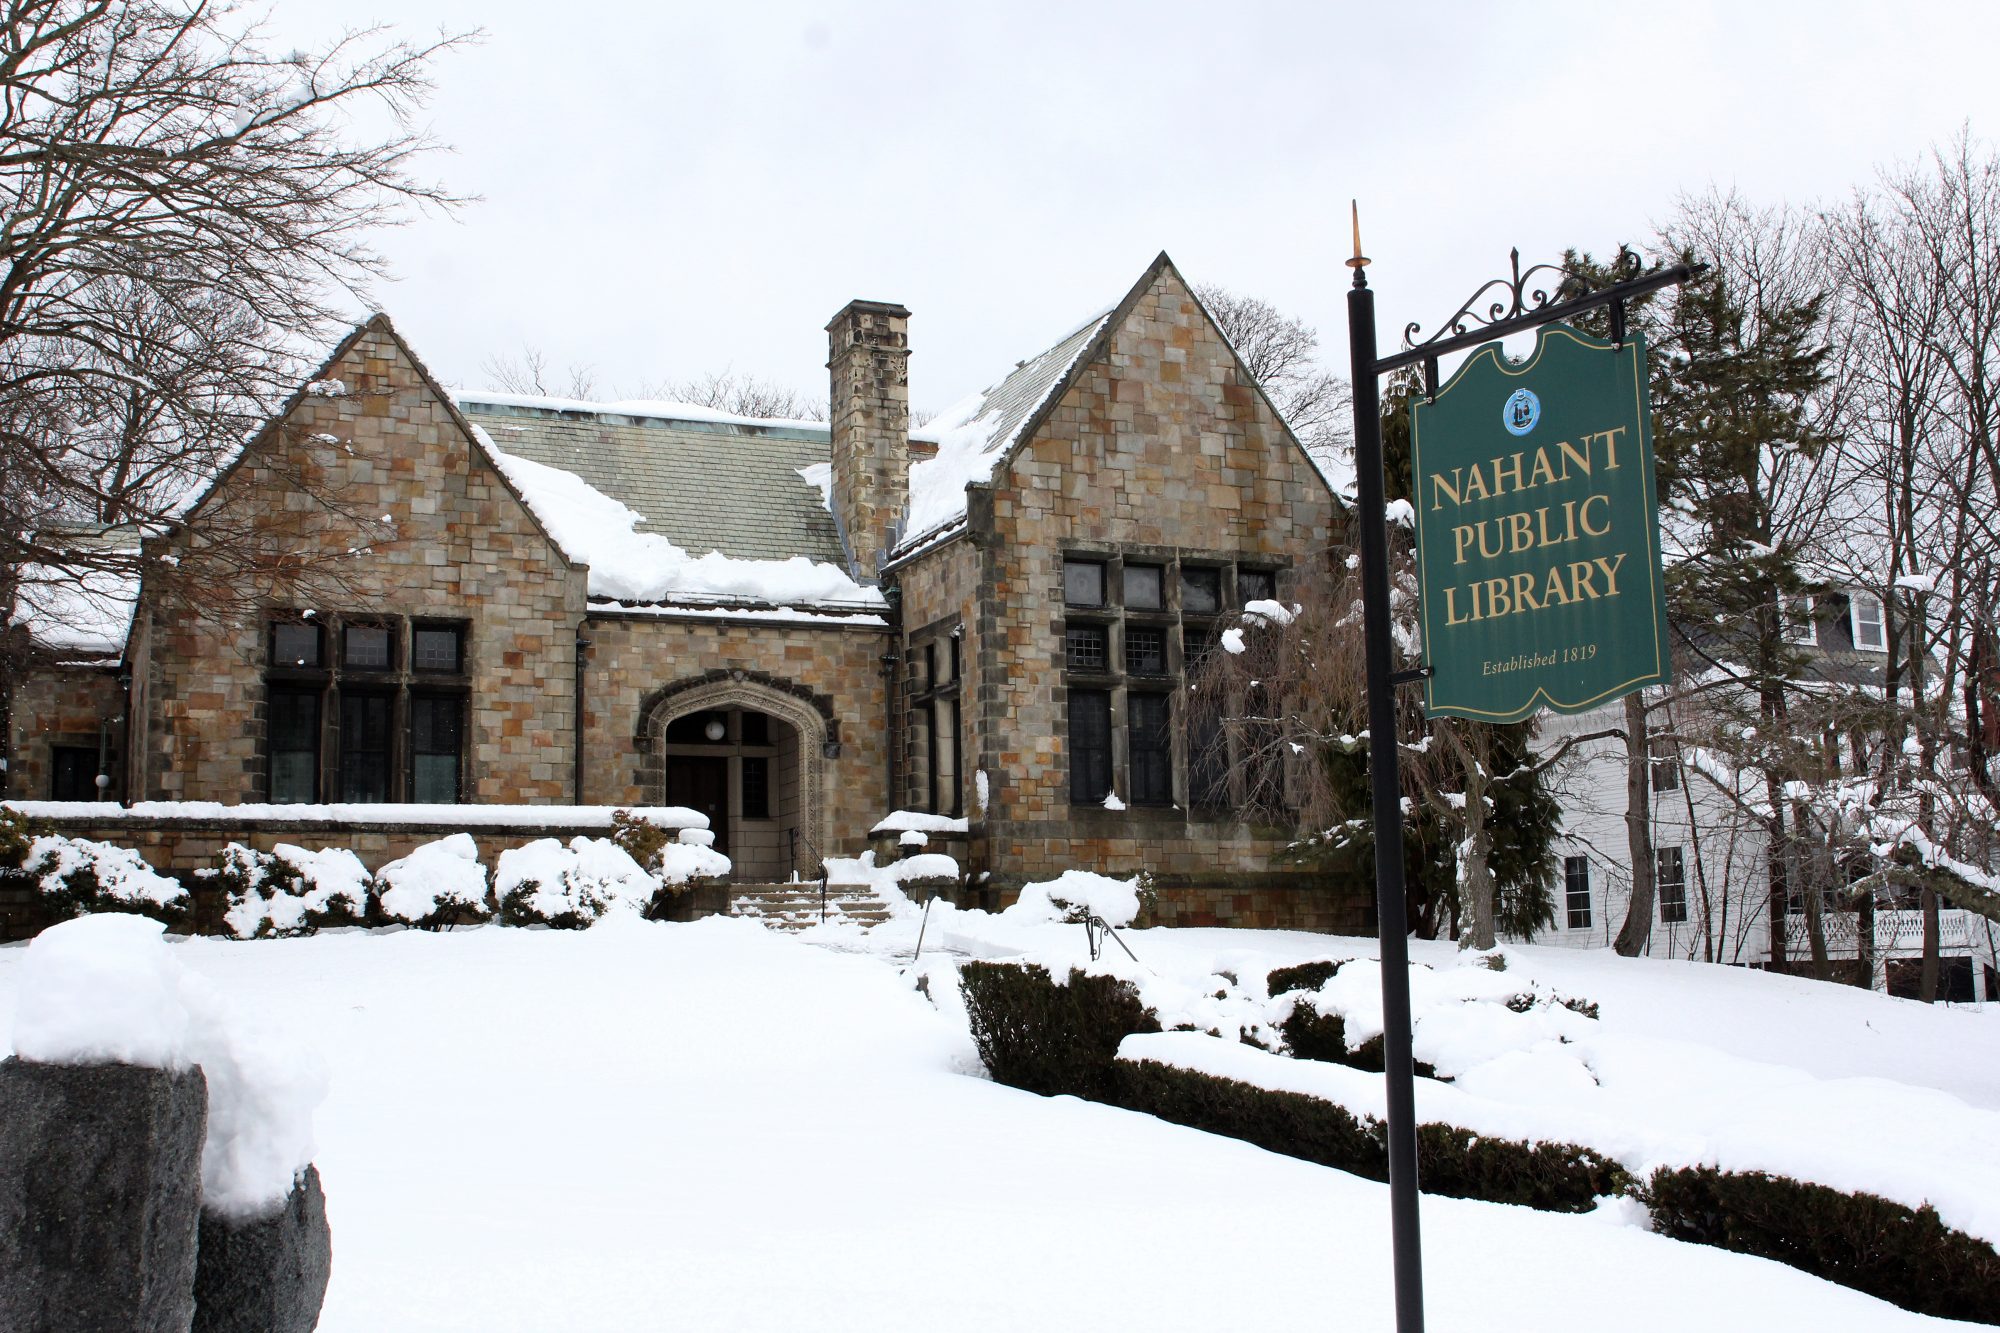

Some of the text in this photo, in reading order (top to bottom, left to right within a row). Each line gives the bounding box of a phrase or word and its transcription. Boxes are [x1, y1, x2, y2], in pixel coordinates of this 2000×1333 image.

[1430, 426, 1626, 511] NAHANT
[1452, 495, 1611, 565] PUBLIC
[1443, 553, 1627, 626] LIBRARY
[1482, 643, 1597, 675] Established 1819
